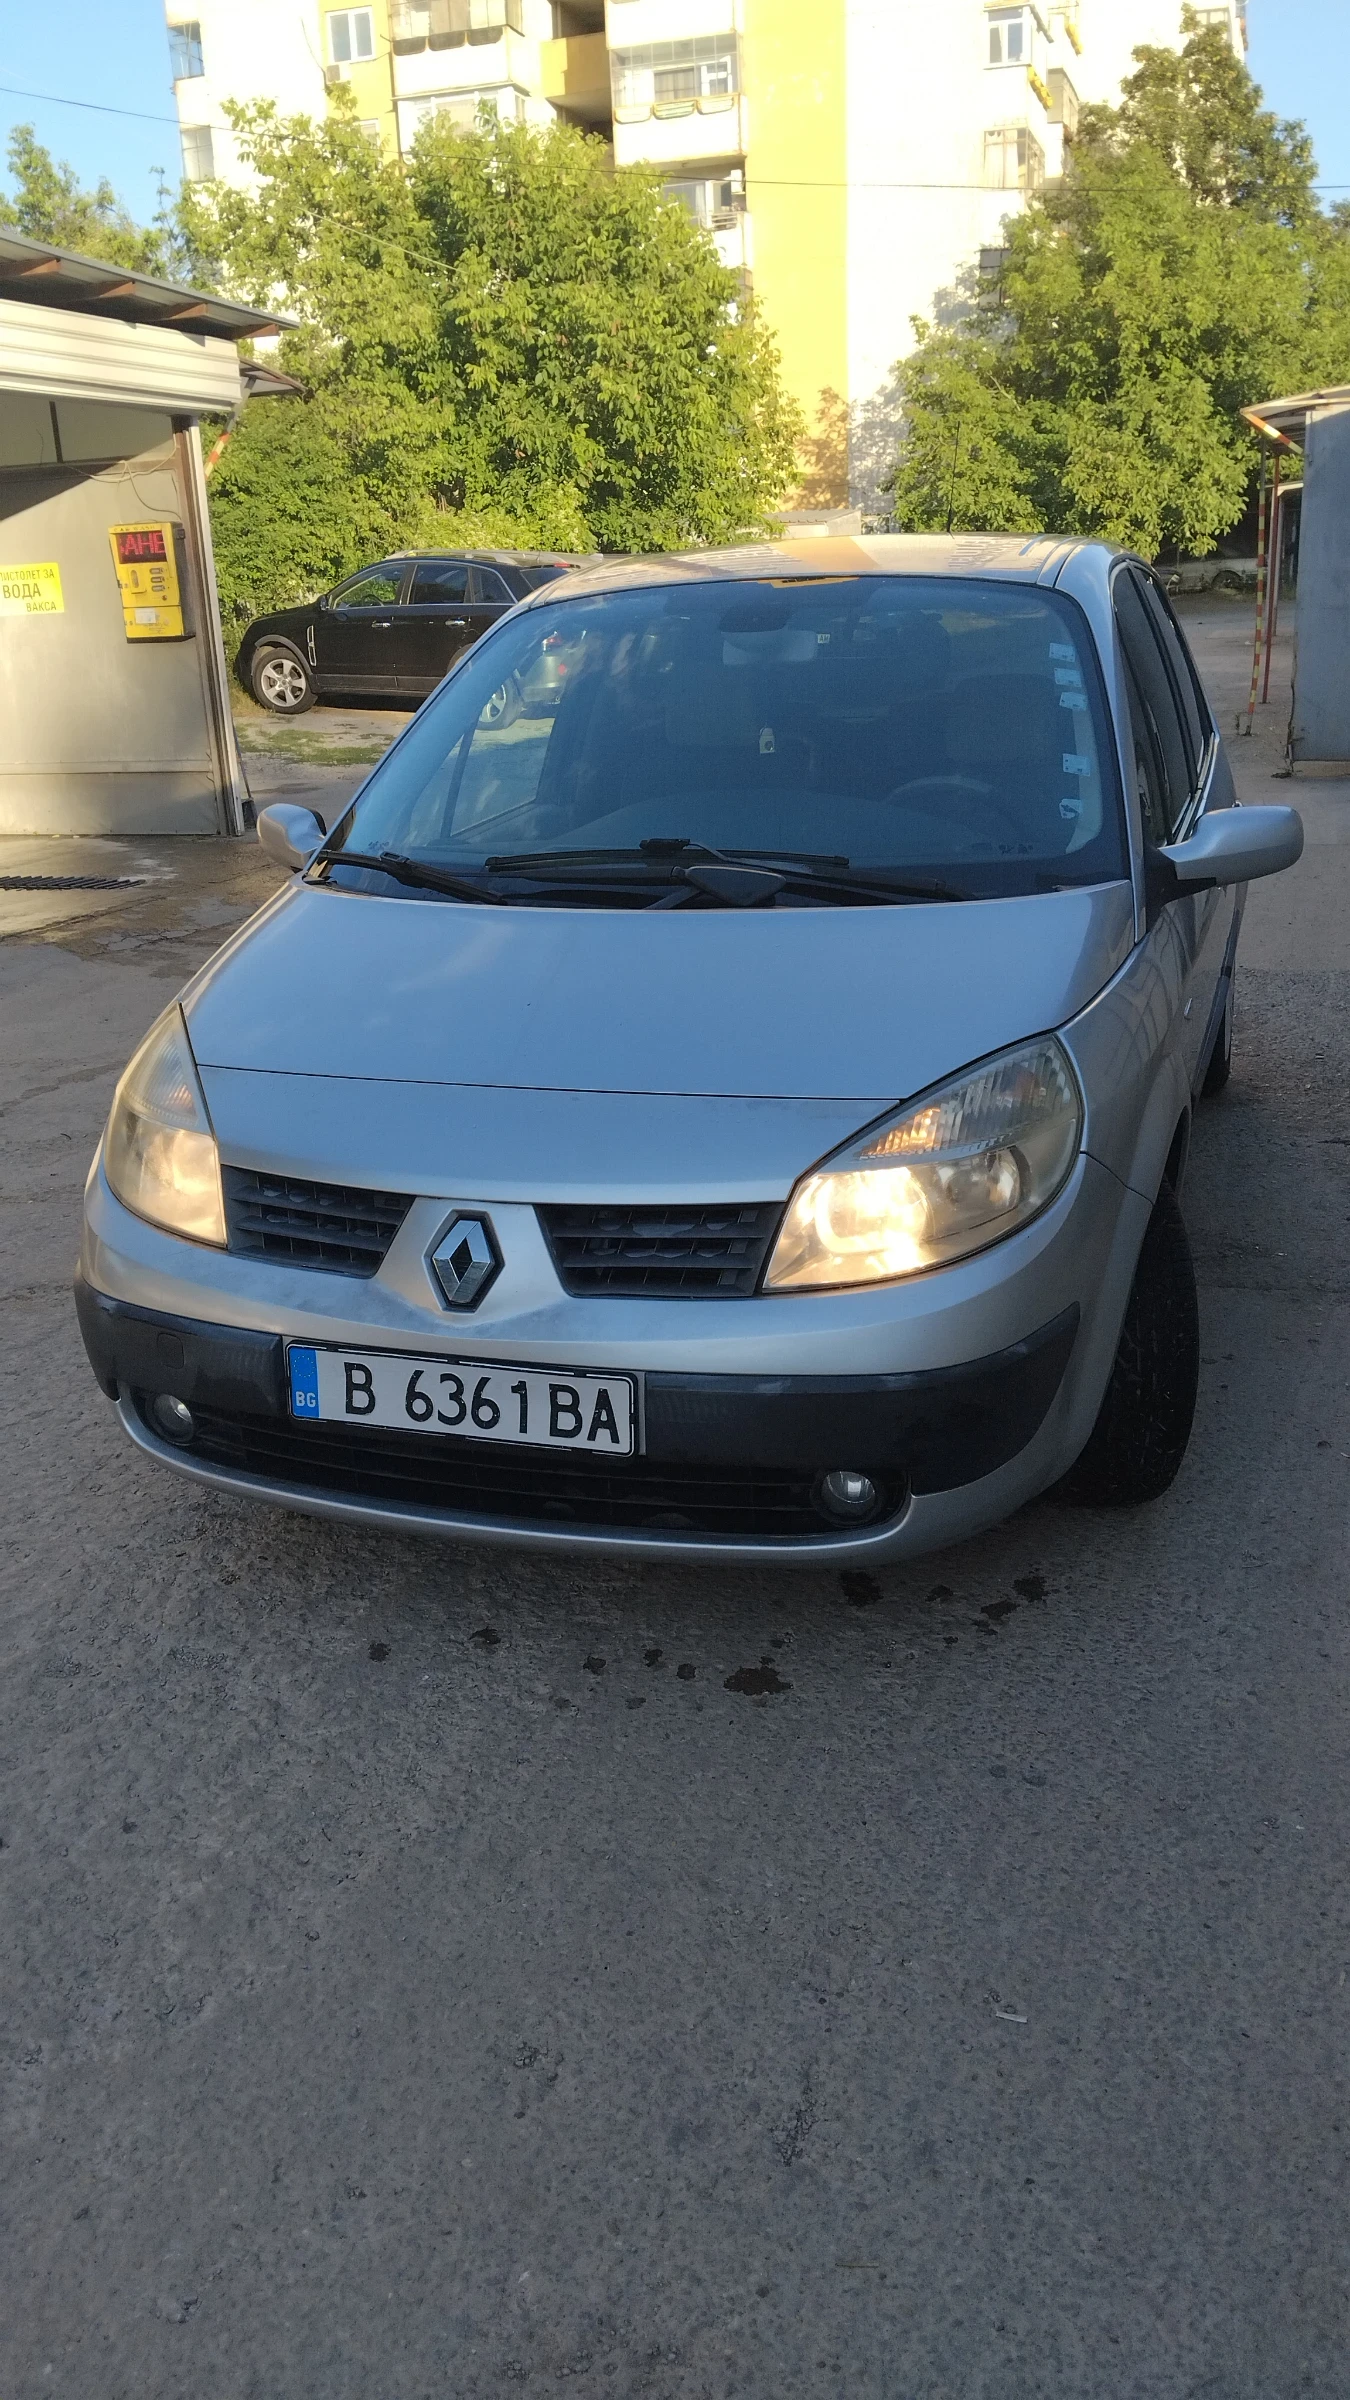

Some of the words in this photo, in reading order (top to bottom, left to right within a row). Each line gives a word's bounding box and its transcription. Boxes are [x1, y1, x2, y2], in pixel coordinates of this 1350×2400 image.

[43, 569, 55, 579] ЗА
[3, 583, 41, 600] ВОДА
[26, 601, 57, 612] ВАКСА
[295, 1391, 316, 1408] BG
[344, 1361, 376, 1415] B
[405, 1369, 528, 1434] 6361
[549, 1382, 620, 1444] BA
